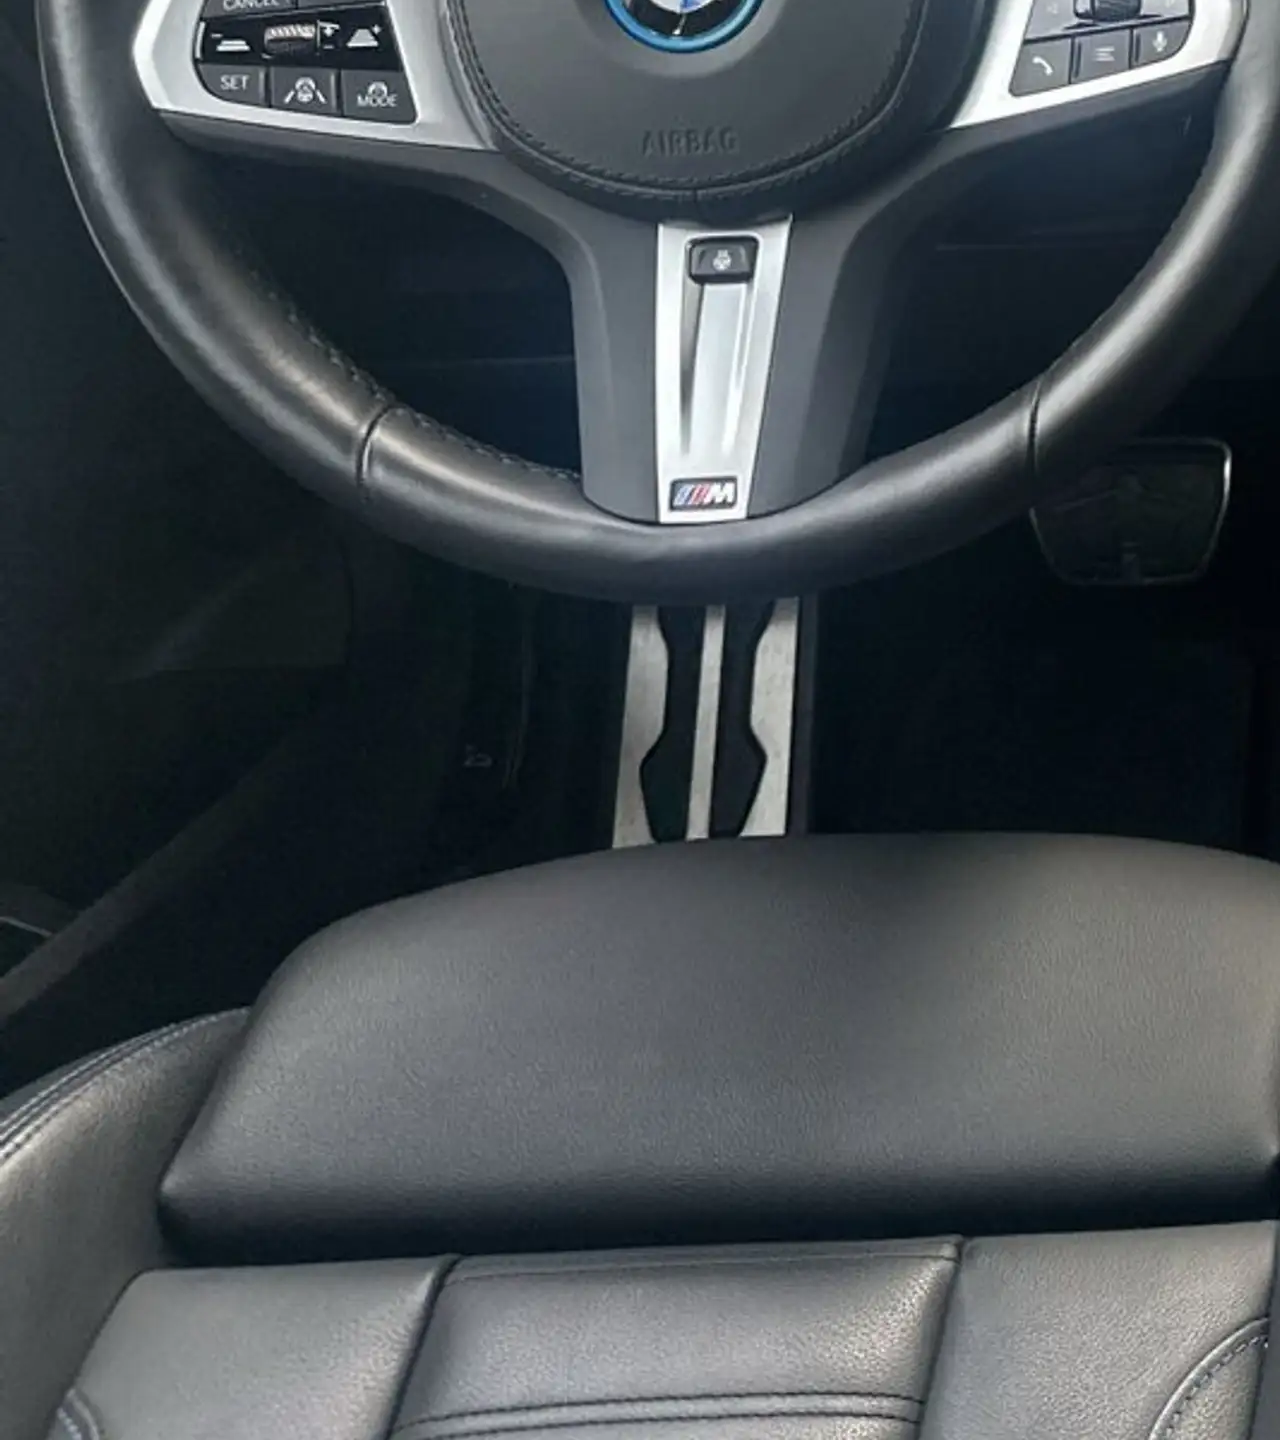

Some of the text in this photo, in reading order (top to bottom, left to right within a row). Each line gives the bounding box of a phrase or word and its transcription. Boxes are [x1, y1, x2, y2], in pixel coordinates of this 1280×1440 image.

[220, 74, 250, 91] SET
[357, 93, 398, 108] MODE
[642, 126, 738, 155] AIRBAG
